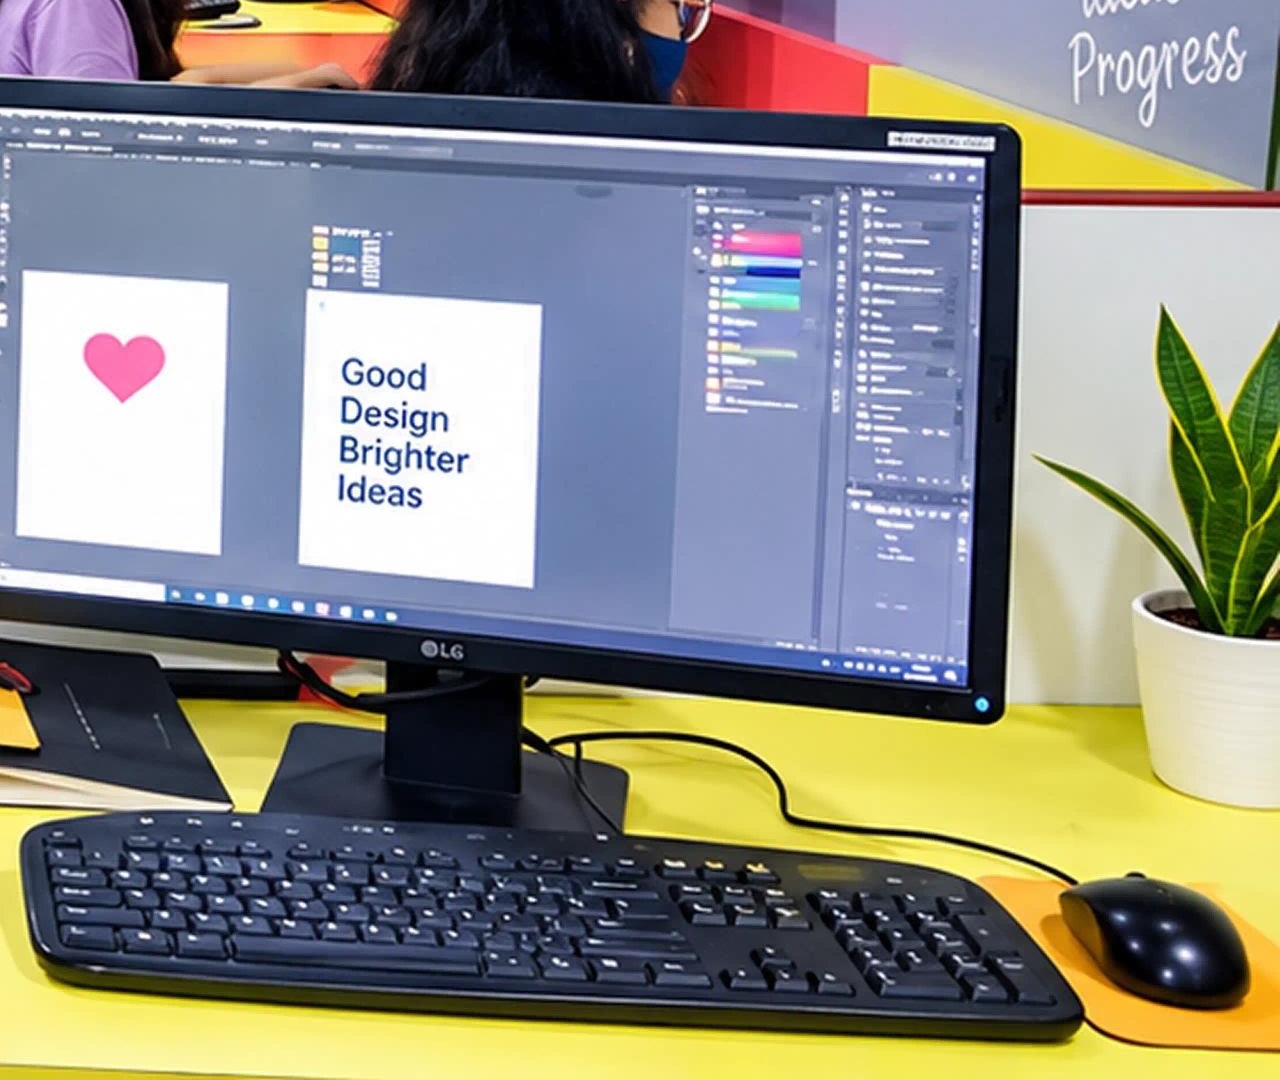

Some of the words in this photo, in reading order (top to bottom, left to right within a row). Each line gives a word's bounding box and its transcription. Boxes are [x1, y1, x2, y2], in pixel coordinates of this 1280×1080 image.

[1068, 26, 1247, 128] Progress
[341, 357, 426, 391] Good
[341, 396, 449, 438] Design
[339, 435, 471, 475] Brighter
[338, 473, 422, 509] Ideas
